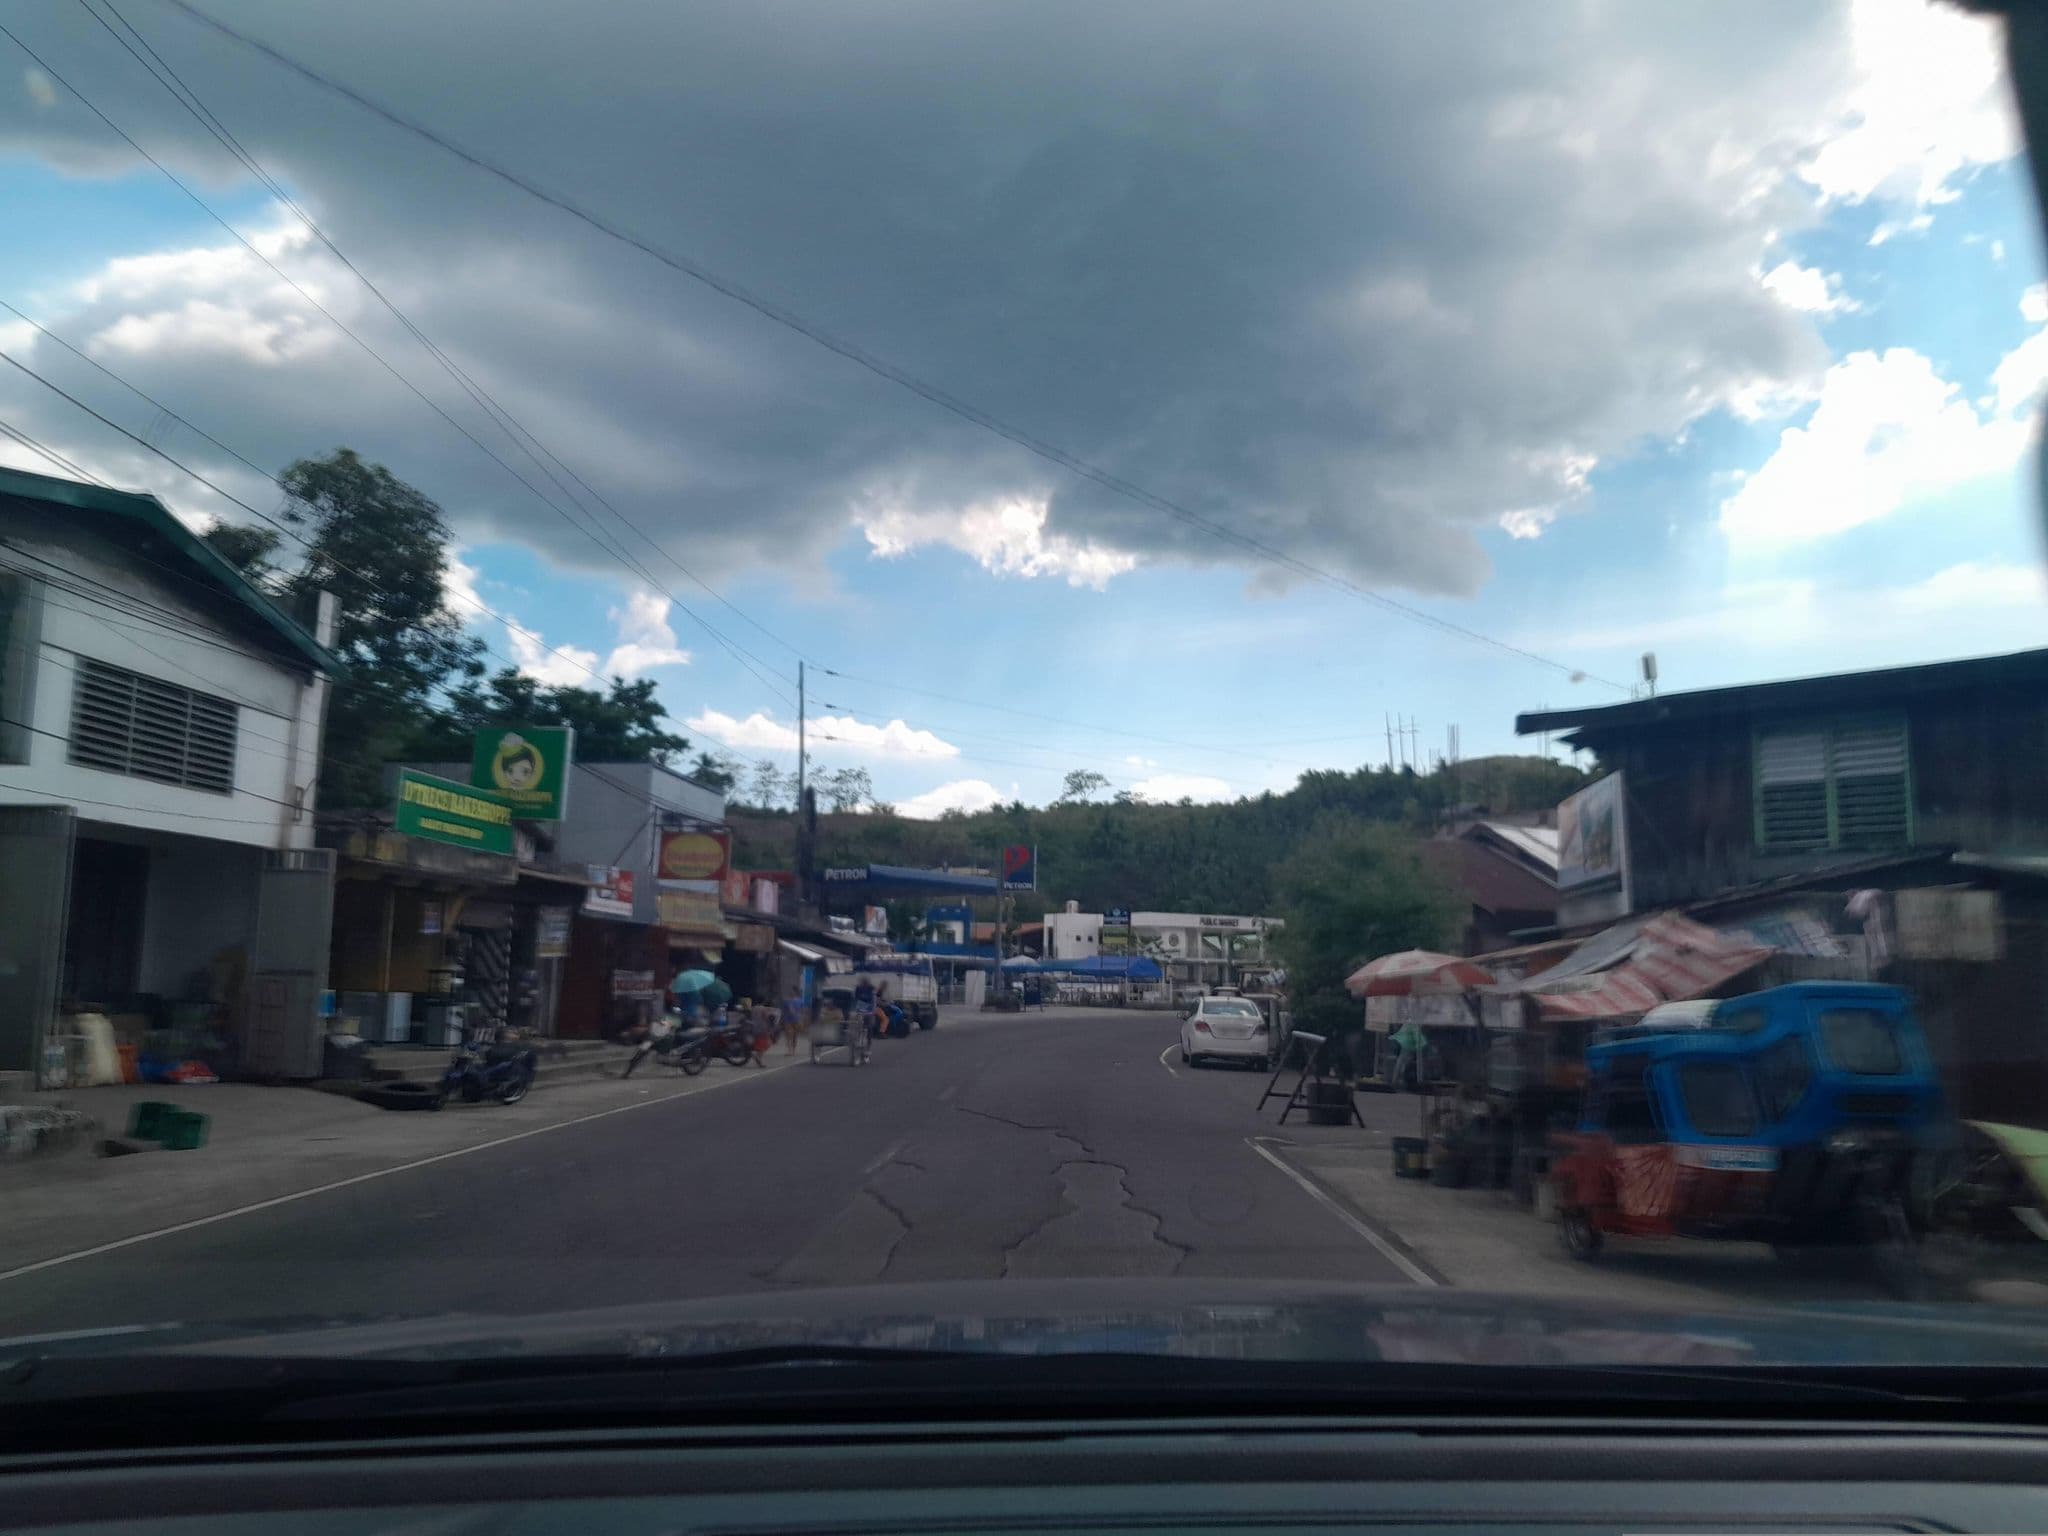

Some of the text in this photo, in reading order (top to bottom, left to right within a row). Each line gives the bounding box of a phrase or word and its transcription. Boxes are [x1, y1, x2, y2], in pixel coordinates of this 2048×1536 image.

[825, 867, 868, 881] PETRON
[1004, 881, 1033, 889] PETRON
[1199, 917, 1217, 927] PUBLIC
